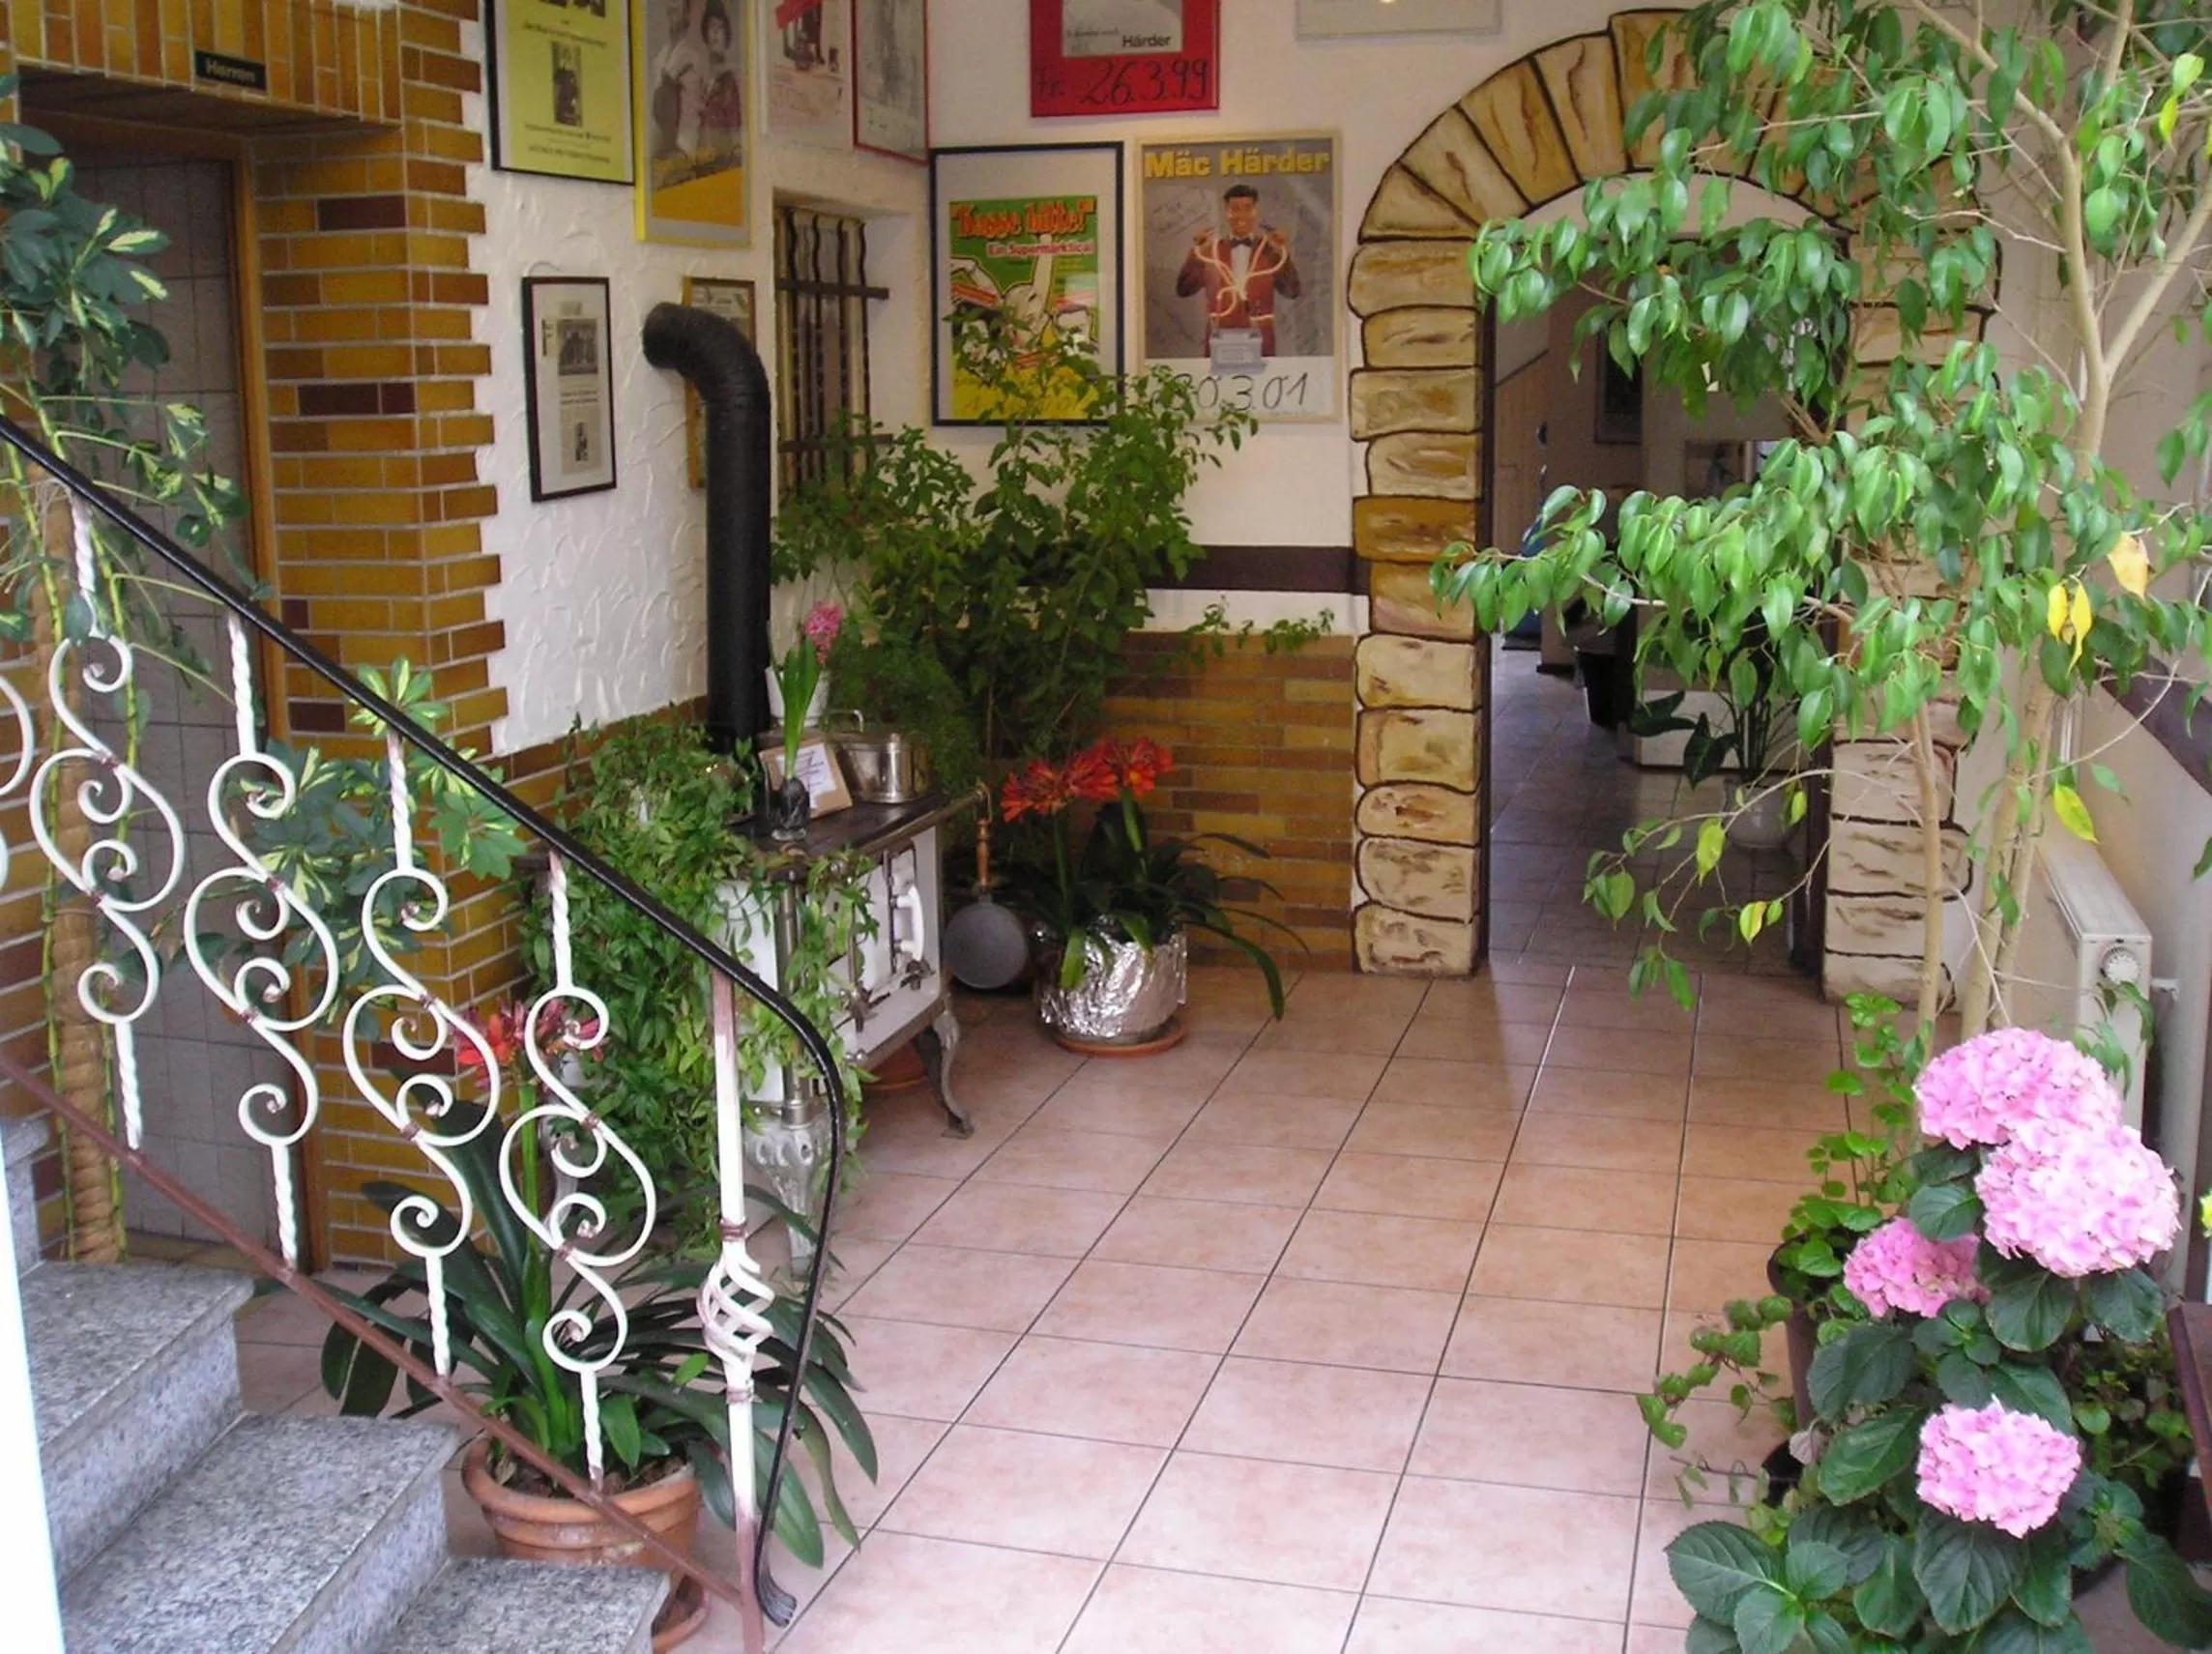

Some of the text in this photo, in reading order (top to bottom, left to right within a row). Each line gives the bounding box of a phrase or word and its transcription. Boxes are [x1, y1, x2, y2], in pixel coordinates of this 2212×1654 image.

[1121, 35, 1172, 48] Härder
[205, 58, 256, 85] Herren
[1144, 146, 1331, 179] Mäc Härder
